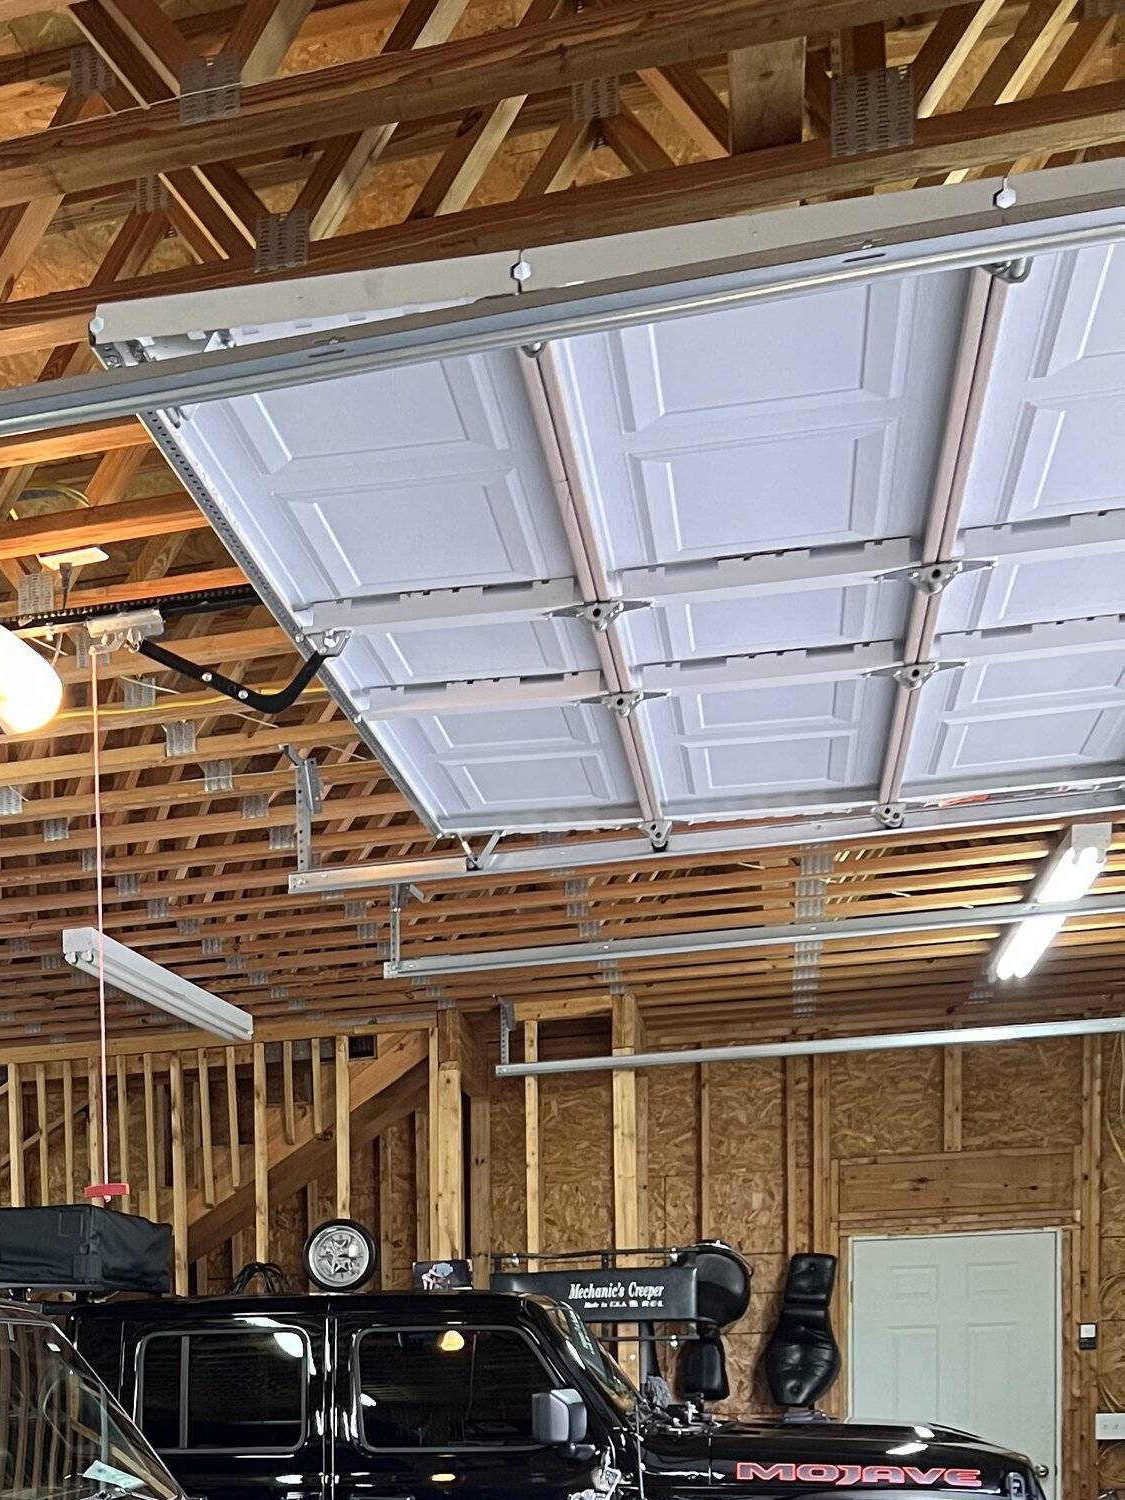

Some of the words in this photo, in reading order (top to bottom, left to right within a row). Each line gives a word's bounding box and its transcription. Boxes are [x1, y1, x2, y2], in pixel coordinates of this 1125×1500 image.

[568, 1282, 625, 1299] Mechanic's
[628, 1282, 665, 1300] Creeper
[737, 1462, 982, 1487] MOJAVE
